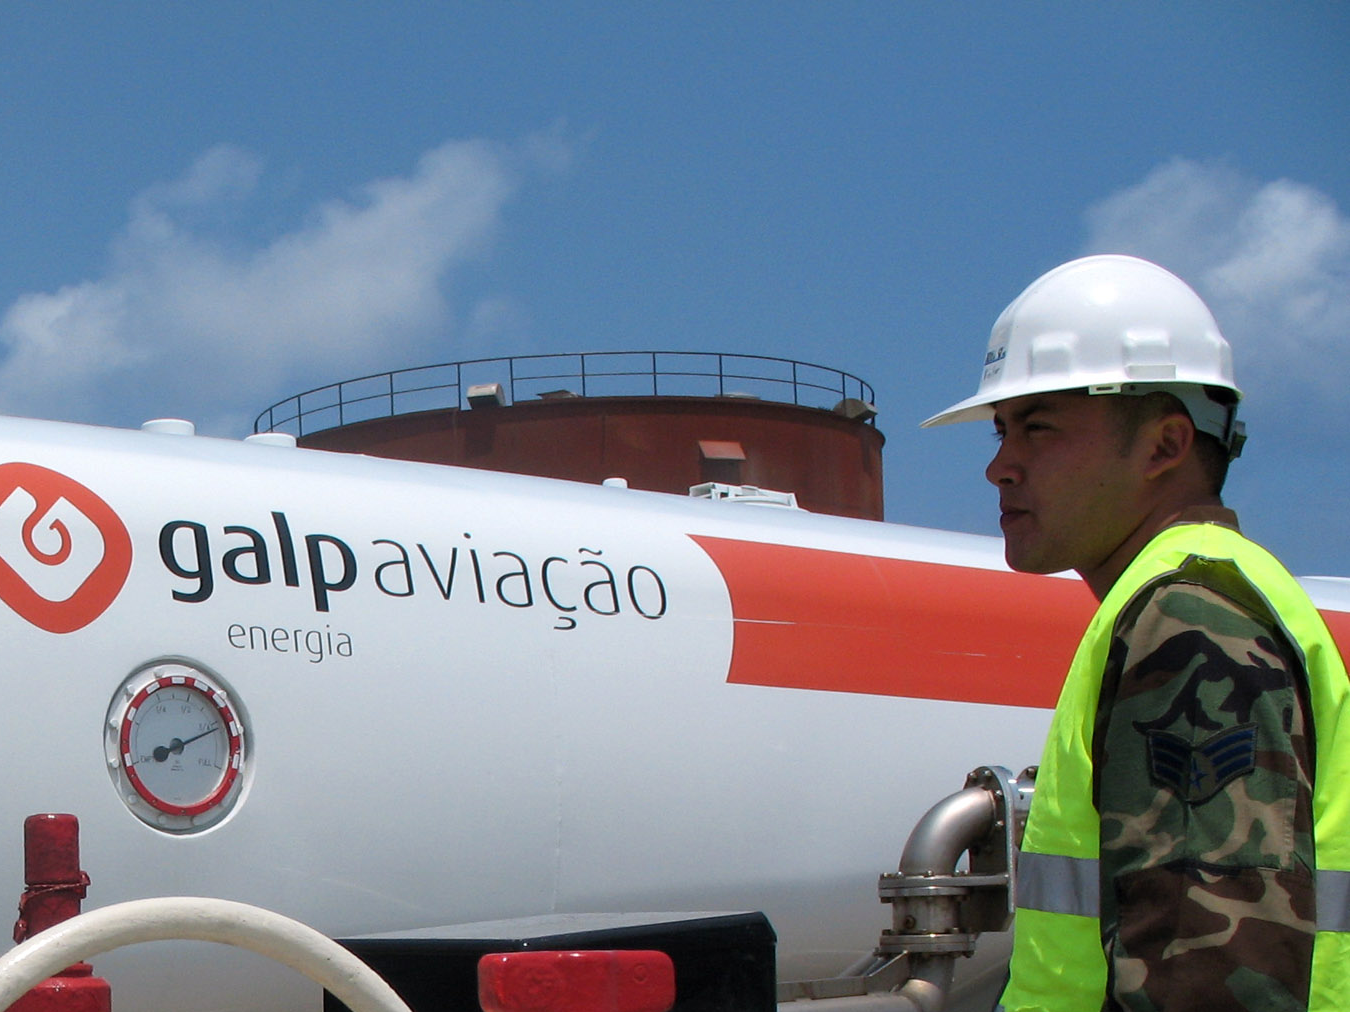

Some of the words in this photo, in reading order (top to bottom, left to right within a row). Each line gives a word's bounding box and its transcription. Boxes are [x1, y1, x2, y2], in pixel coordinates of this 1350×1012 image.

[158, 510, 358, 613] galp
[371, 532, 669, 631] aviação
[227, 623, 354, 664] energia
